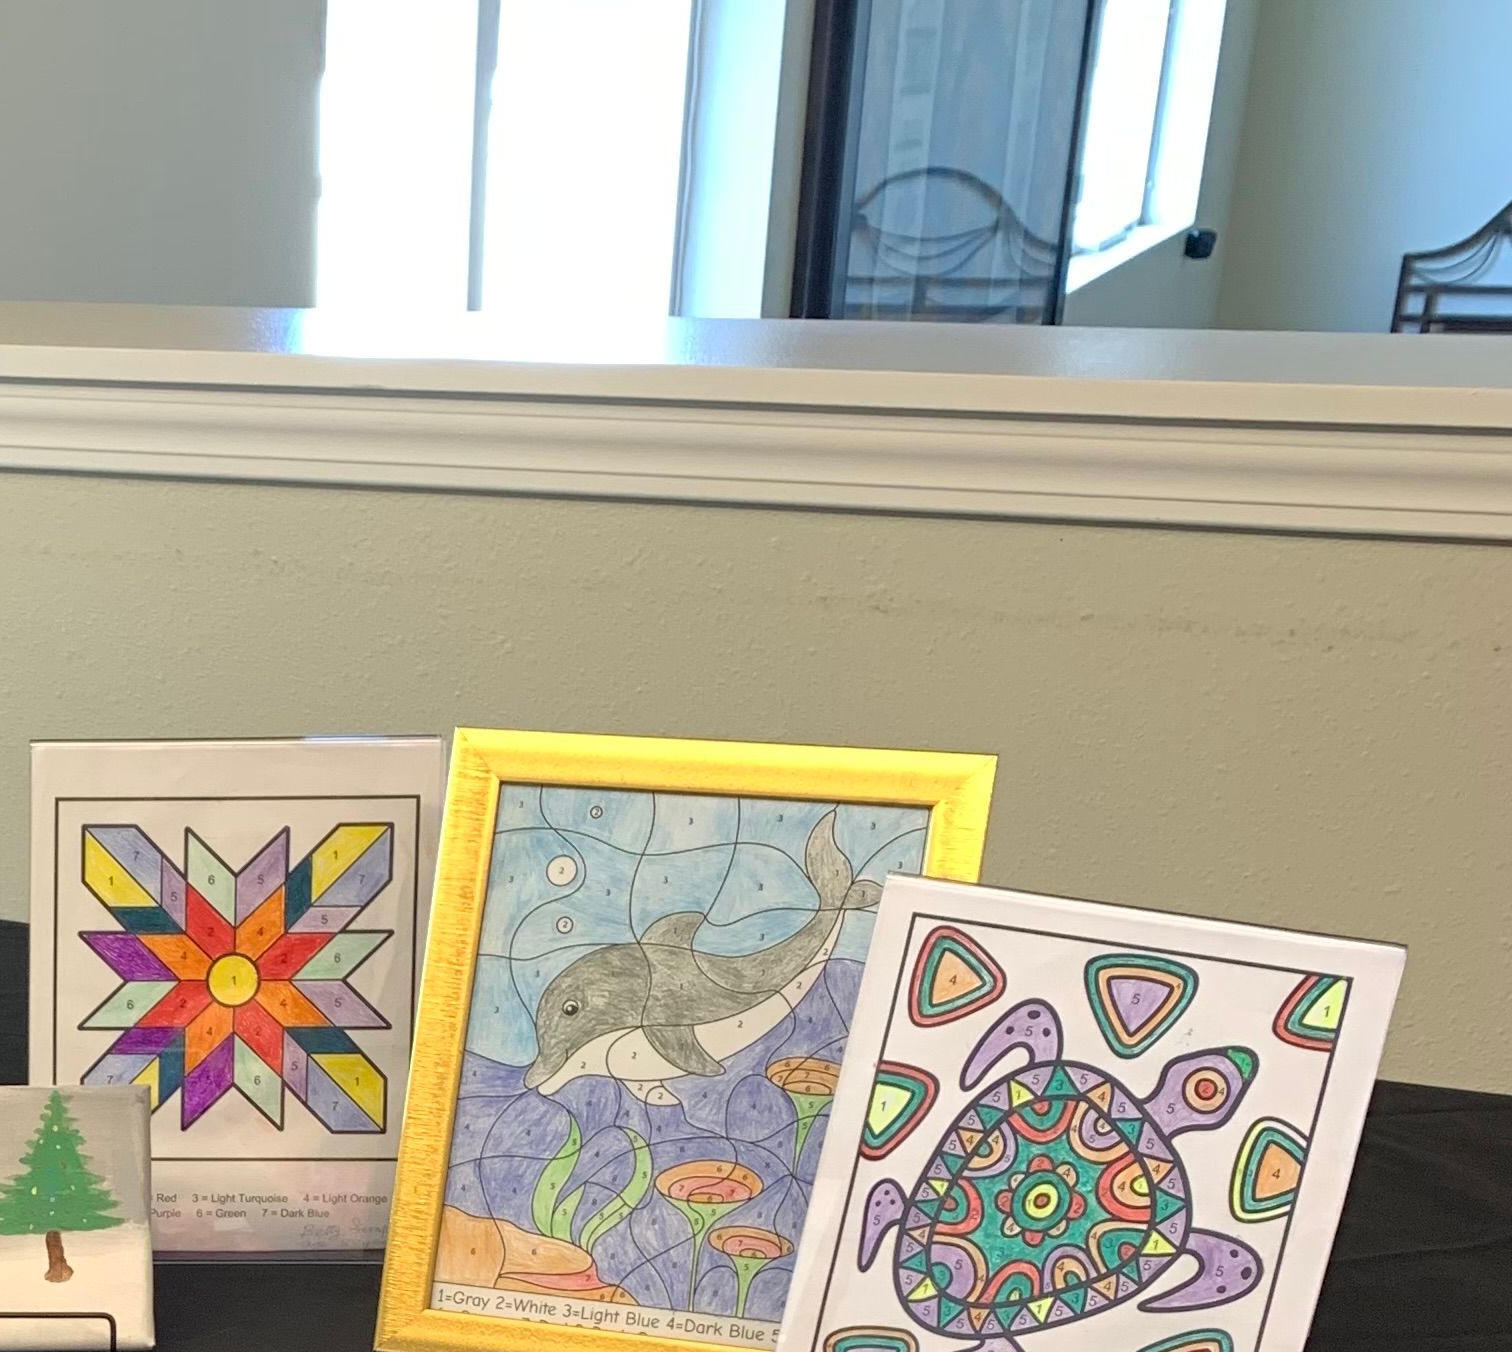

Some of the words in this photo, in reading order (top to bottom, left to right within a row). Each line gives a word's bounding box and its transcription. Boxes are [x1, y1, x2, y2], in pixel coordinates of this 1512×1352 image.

[559, 867, 565, 875] 2
[108, 876, 114, 886] 1
[208, 875, 215, 885] 6
[258, 874, 264, 885] 5
[359, 874, 365, 884] 7
[170, 892, 178, 902] 5
[321, 915, 328, 925] 5
[208, 927, 214, 937] 2
[257, 927, 264, 936] 4
[181, 951, 187, 960] 4
[823, 948, 829, 956] 2
[280, 954, 287, 963] 2
[334, 953, 341, 963] 6
[232, 975, 237, 985] 1
[796, 981, 802, 989] 2
[949, 975, 958, 986] 4
[180, 999, 186, 1008] 2
[280, 998, 287, 1008] 4
[334, 998, 342, 1008] 5
[1131, 993, 1141, 1005] 5
[127, 1000, 134, 1010] 6
[1323, 1005, 1330, 1018] 1
[737, 1020, 744, 1029] 2
[206, 1026, 212, 1036] 4
[255, 1026, 262, 1036] 2
[1024, 1026, 1033, 1037] 5
[631, 1052, 637, 1060] 2
[291, 1061, 298, 1071] 5
[580, 1061, 587, 1069] 2
[107, 1075, 114, 1084] 7
[254, 1075, 261, 1085] 6
[355, 1077, 360, 1086] 1
[1031, 1074, 1040, 1085] 5
[637, 1083, 644, 1091] 2
[657, 1092, 663, 1100] 2
[992, 1091, 1001, 1102] 5
[1097, 1092, 1106, 1102] 4
[332, 1101, 338, 1111] 7
[808, 1101, 815, 1109] 5
[880, 1101, 886, 1111] 1
[1118, 1102, 1126, 1113] 5
[1166, 1102, 1176, 1115] 5
[967, 1115, 976, 1126] 5
[948, 1139, 957, 1150] 5
[1146, 1138, 1155, 1149] 5
[716, 1166, 723, 1174] 6
[1152, 1163, 1160, 1172] 4
[1271, 1168, 1281, 1180] 4
[550, 1182, 556, 1190] 5
[1118, 1181, 1126, 1191] 4
[156, 1193, 177, 1203] Red
[192, 1193, 199, 1203] 3
[211, 1193, 236, 1205] Light
[239, 1193, 289, 1205] Turquoise
[303, 1194, 310, 1202] 4
[322, 1193, 347, 1205] Light
[350, 1193, 388, 1205] Orange
[151, 1209, 181, 1219] Purple
[196, 1209, 203, 1218] 6
[215, 1209, 246, 1218] Green
[261, 1209, 268, 1217] 7
[281, 1208, 305, 1218] Dark
[308, 1208, 330, 1218] Blue
[562, 1208, 568, 1216] 5
[873, 1215, 881, 1226] 5
[1169, 1223, 1178, 1234] 5
[1153, 1240, 1159, 1250] 1
[470, 1247, 476, 1256] 6
[531, 1248, 537, 1256] 6
[954, 1259, 963, 1270] 5
[1215, 1265, 1224, 1277] 5
[437, 1289, 490, 1310] 1=Gray
[495, 1296, 557, 1316] 2=White
[562, 1304, 621, 1325] 3=Light
[625, 1311, 660, 1329] Blue
[666, 1317, 723, 1337] 4=Dark
[729, 1323, 765, 1341] Blue
[923, 1305, 930, 1316] 5
[1055, 1305, 1063, 1316] 5
